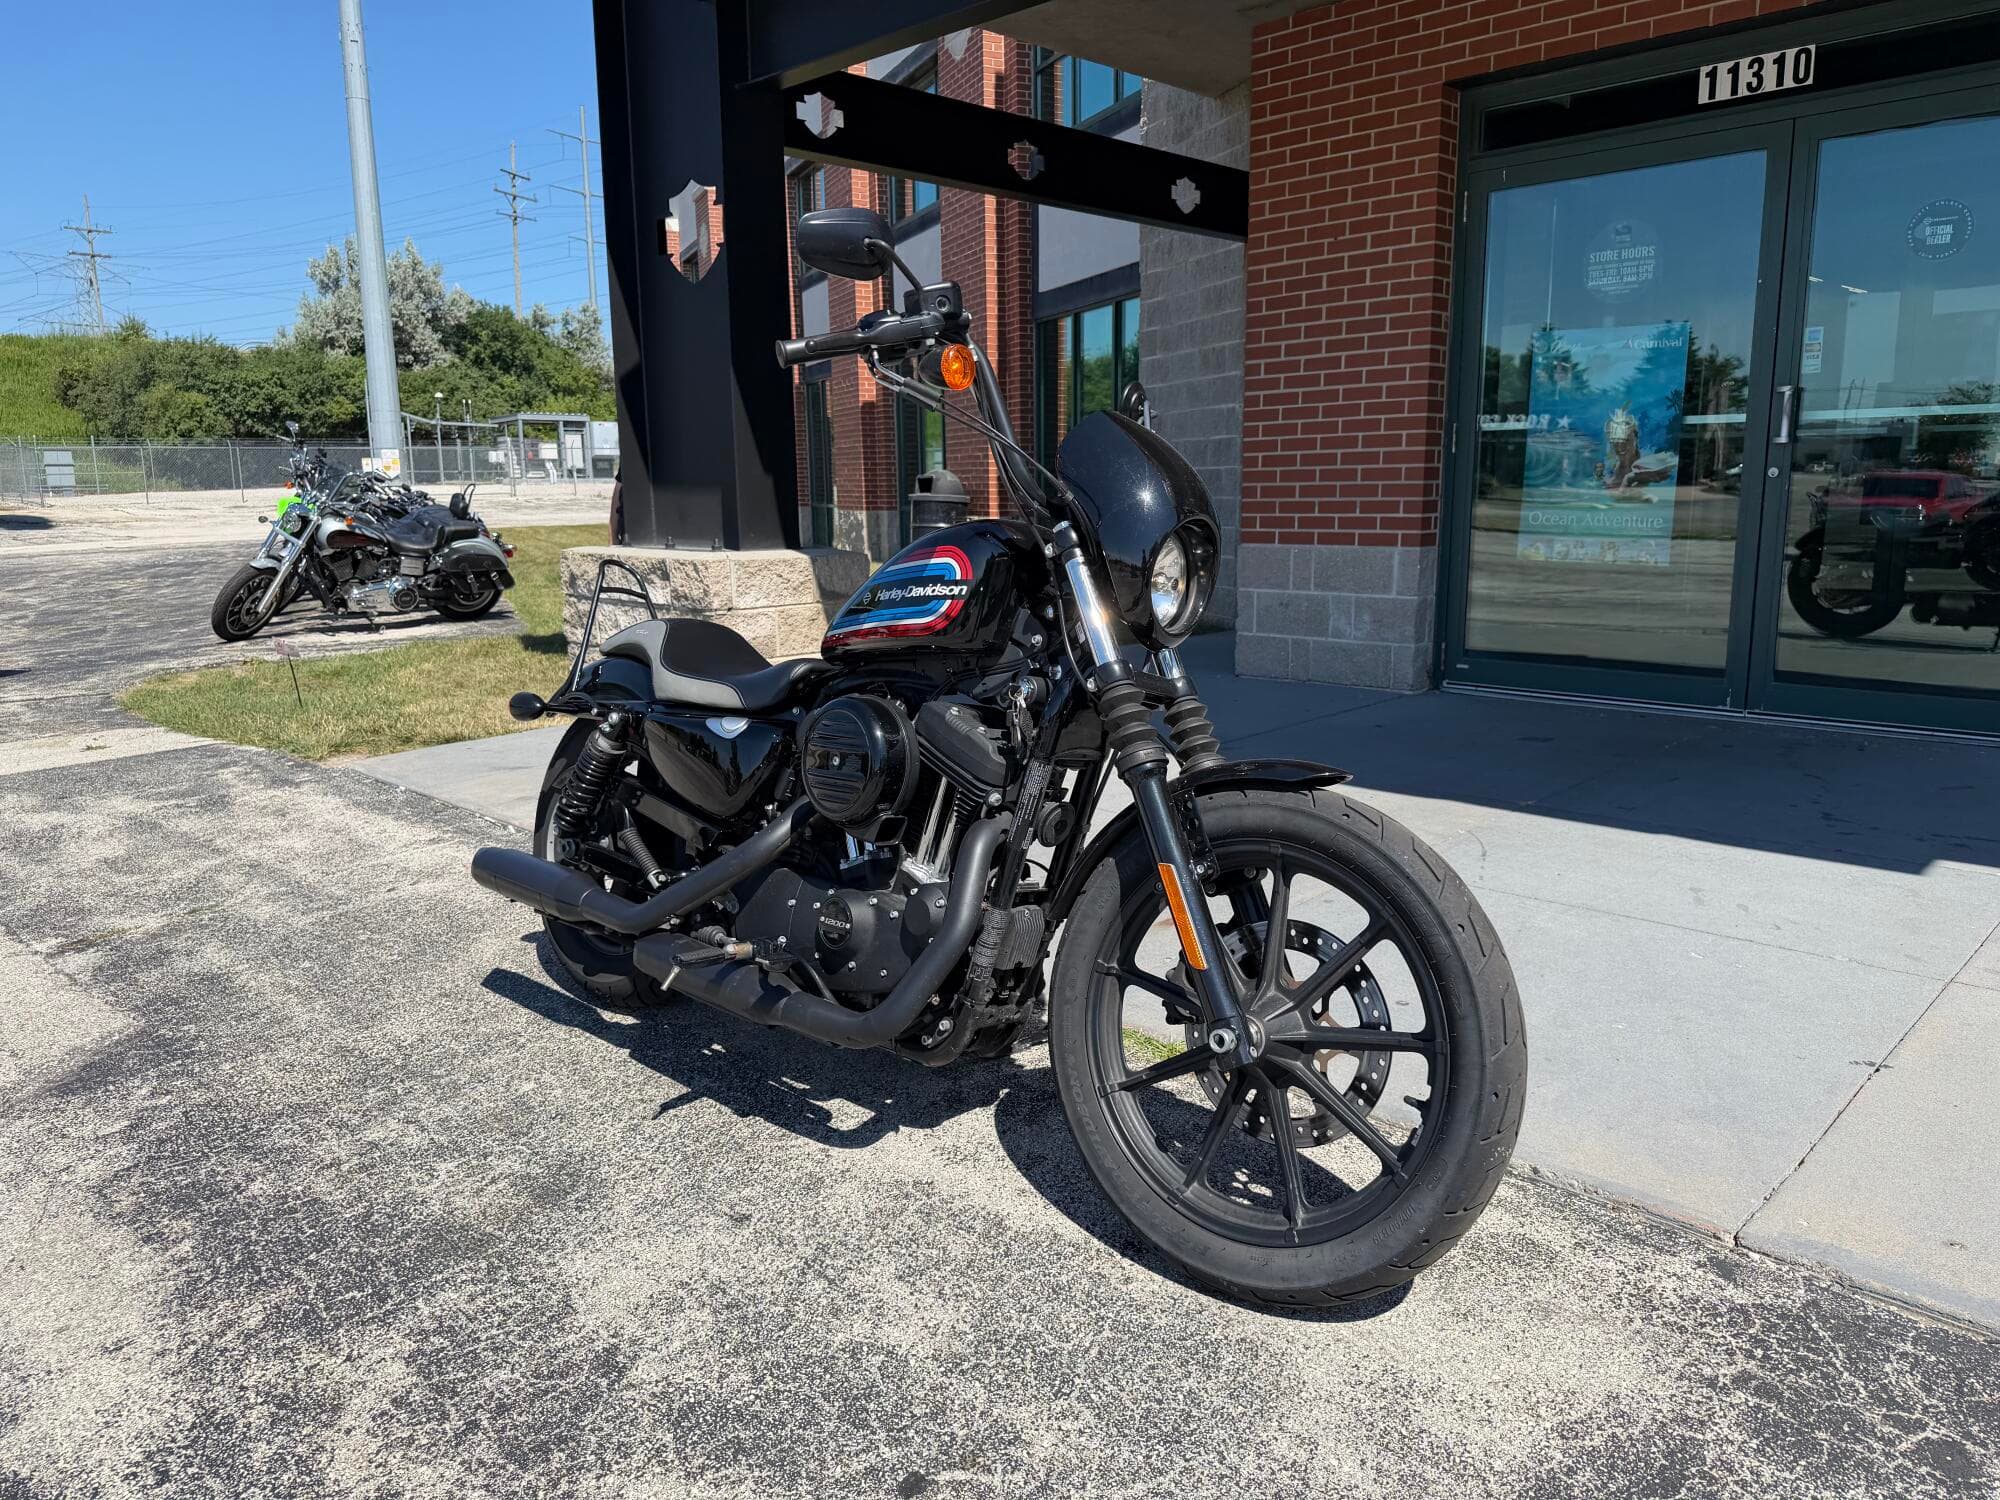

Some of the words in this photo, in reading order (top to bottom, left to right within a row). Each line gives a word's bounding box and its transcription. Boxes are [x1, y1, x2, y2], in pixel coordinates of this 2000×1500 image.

[1705, 47, 1812, 100] 11310
[1925, 224, 1954, 236] OFFICIAL
[1926, 234, 1951, 245] DEALER
[1590, 250, 1619, 263] STORE
[1621, 246, 1656, 260] HOURS
[1634, 337, 1682, 349] Carnival
[1528, 510, 1577, 526] Ocean
[1580, 511, 1664, 528] Adventure
[874, 583, 967, 602] Harley-Davidson
[824, 917, 846, 928] 1200
